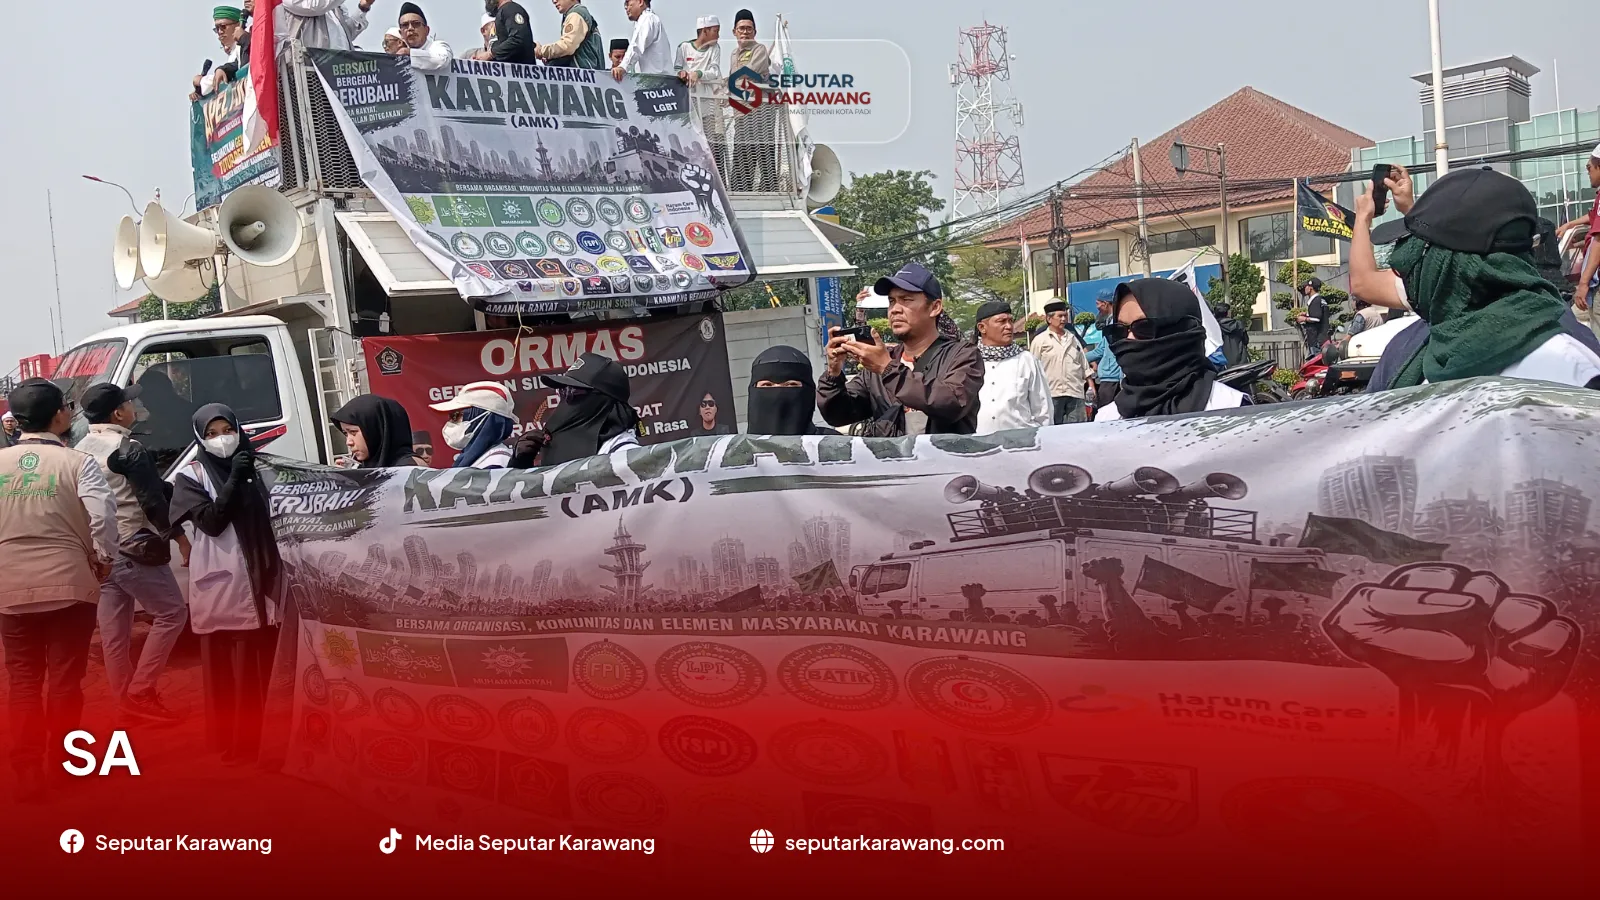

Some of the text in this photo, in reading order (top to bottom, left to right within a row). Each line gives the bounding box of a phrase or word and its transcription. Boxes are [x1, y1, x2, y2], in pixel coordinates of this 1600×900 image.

[332, 60, 380, 76] BERSATU,
[450, 61, 596, 84] ALIANSI MASYARAKAT
[336, 74, 381, 87] BERGERAK,
[424, 74, 629, 121] KARAWANG
[642, 89, 675, 100] TOLAK
[653, 102, 678, 113] LGBT
[510, 113, 559, 130] (AMK)
[455, 184, 483, 192] BERSAMA
[544, 209, 558, 217] FPI
[1303, 216, 1328, 227] BINA
[653, 293, 688, 304] KARAWANG
[485, 302, 558, 314] AMANAH RAKYAT
[480, 325, 645, 376] ORMAS
[653, 419, 689, 434] Rasa
[270, 480, 342, 495] BERGERAK,
[268, 488, 367, 518] ERUBAH!
[560, 476, 695, 519] (AMK)
[296, 518, 357, 533] DITEGAKAN!
[396, 616, 1028, 649] BERSAMA ORGANISASI, KOMUNITAS DAN ELEMEN MASYARAKAT KARAWANG
[590, 662, 621, 680] FPI
[686, 660, 726, 675] LPI
[473, 677, 552, 686] MUHAMMADIYAH
[808, 670, 873, 684] BATIK
[1158, 692, 1368, 719] Harum Care
[1161, 705, 1324, 732] Indonesia
[680, 736, 729, 756] FSPI
